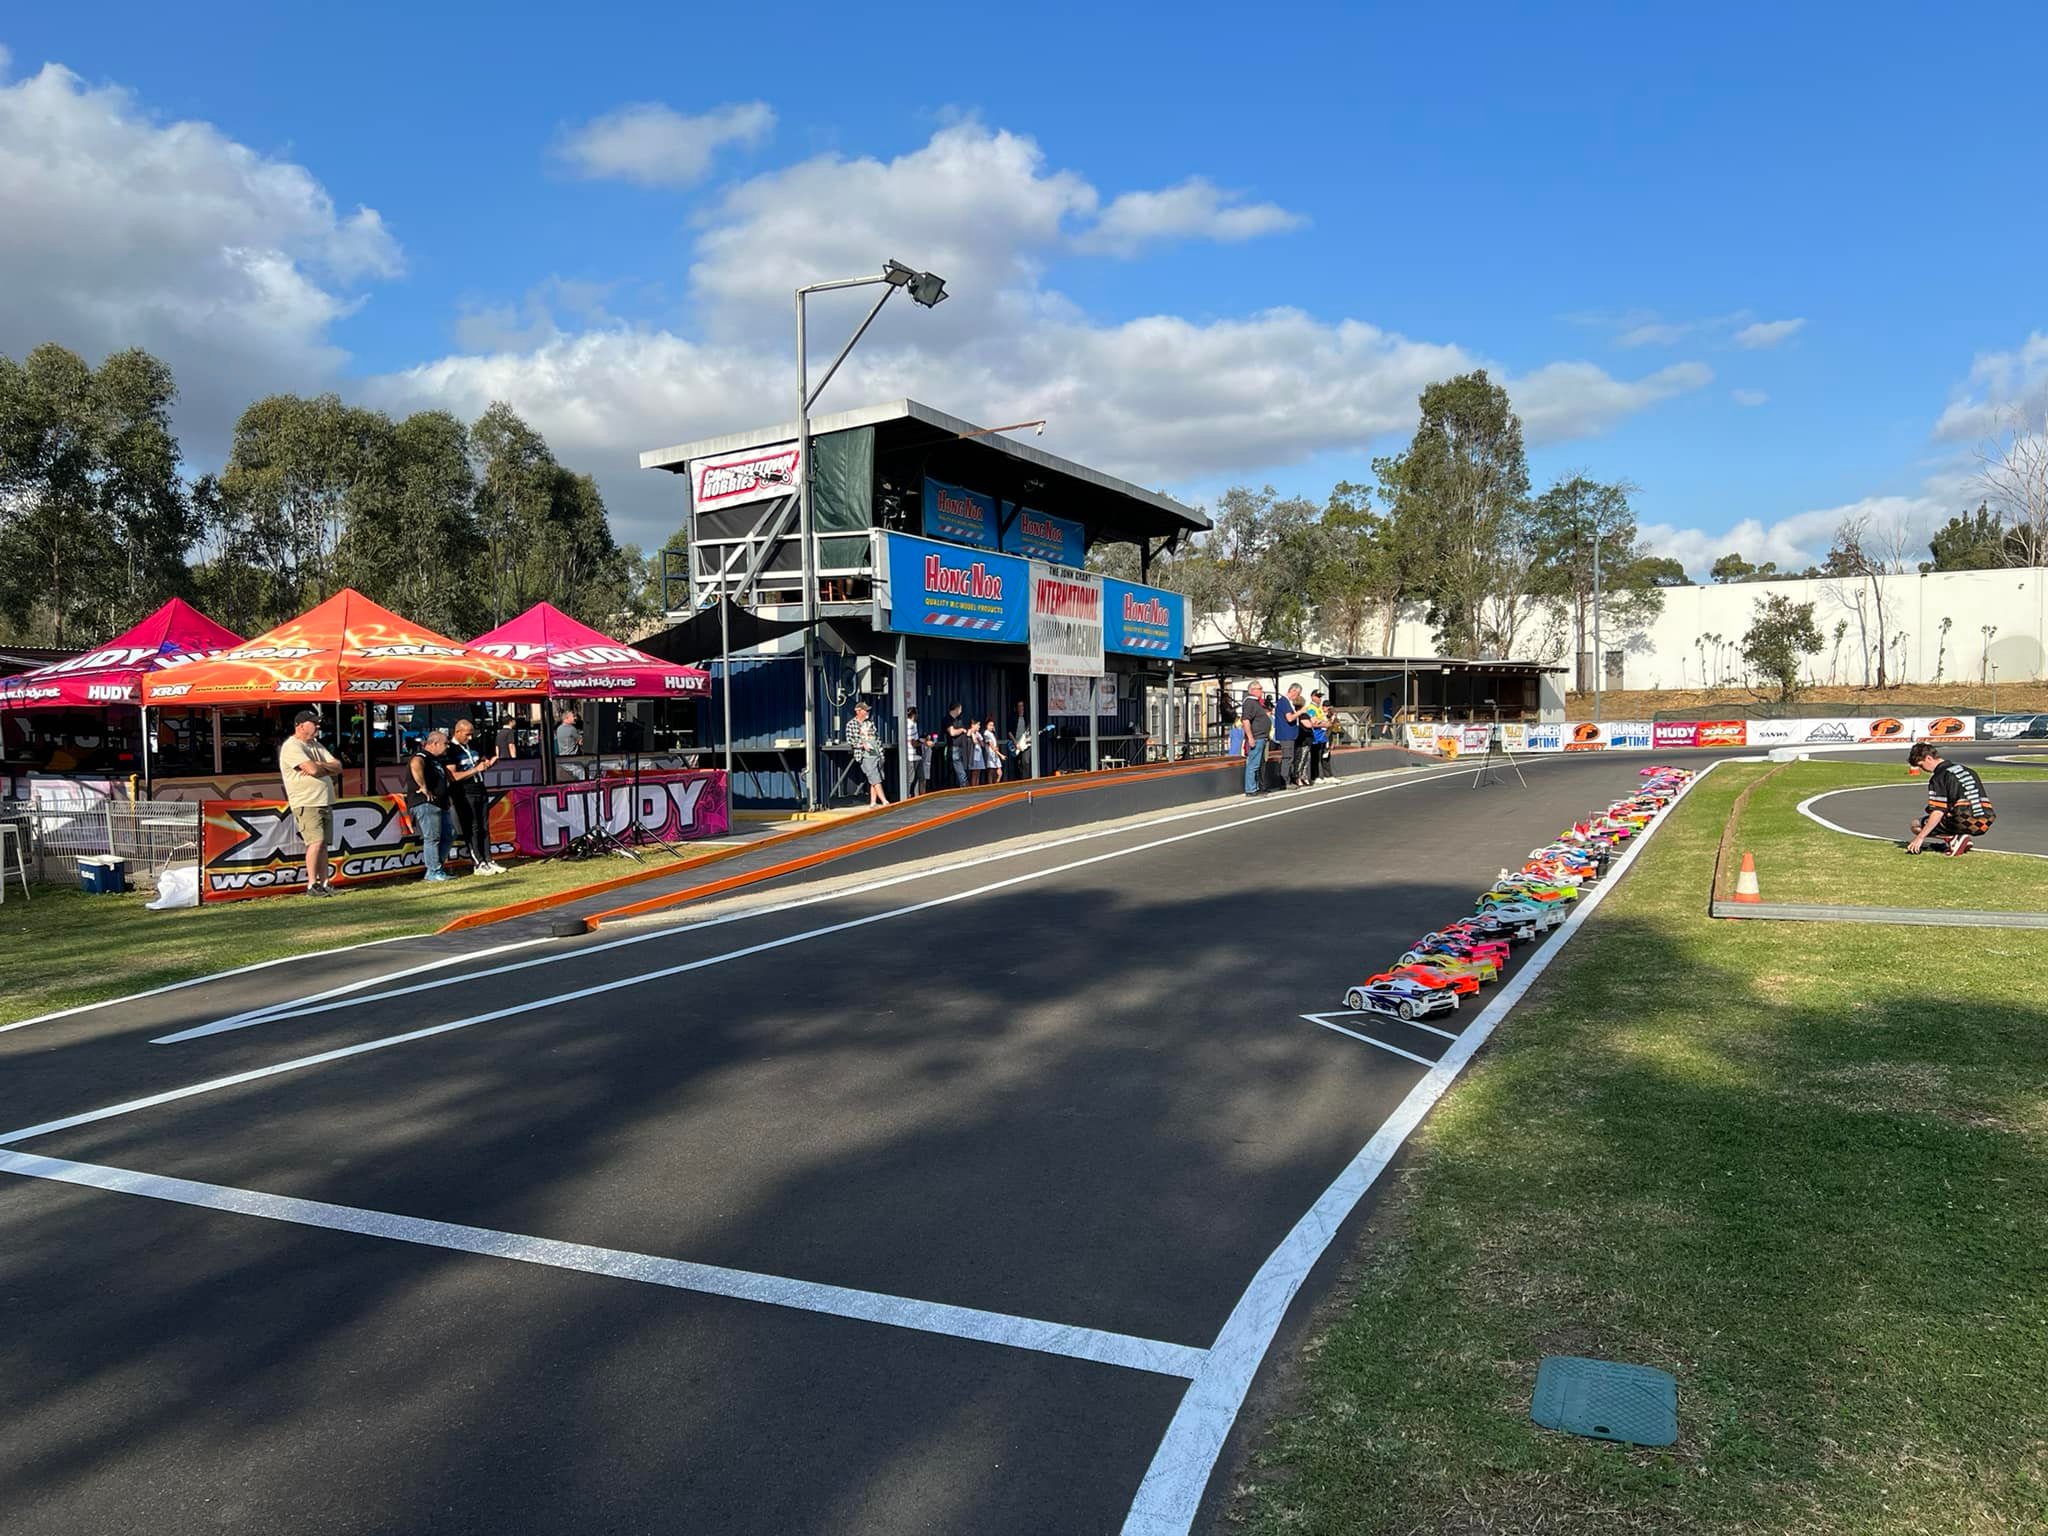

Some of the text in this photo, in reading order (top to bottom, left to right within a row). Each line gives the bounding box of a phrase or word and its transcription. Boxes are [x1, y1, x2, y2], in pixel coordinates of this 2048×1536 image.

[702, 476, 756, 498] HOBBIES
[925, 554, 1003, 601] HONG NOR
[1049, 566, 1059, 577] THE
[1061, 568, 1074, 580] JOHN
[925, 597, 949, 607] QUALITY
[978, 604, 1003, 615] PRODUCTS
[1036, 577, 1099, 621] INTERNATIONAL
[1123, 591, 1169, 627] HONG NOR
[1065, 622, 1102, 658] RACEWAY
[361, 644, 469, 658] XRAY
[547, 646, 648, 668] HUDY
[149, 684, 194, 698] XRAY
[274, 680, 329, 693] XRAY
[347, 679, 406, 692] XRAY
[492, 679, 543, 691] XRAY
[553, 676, 706, 690] www.hudy.net HUDY
[87, 685, 134, 700] HUDY
[1611, 722, 1650, 735] RUNNER
[1656, 727, 1697, 738] HUDY
[1538, 737, 1560, 748] TIME
[1628, 736, 1650, 747] TIME
[538, 779, 707, 847] HUDY
